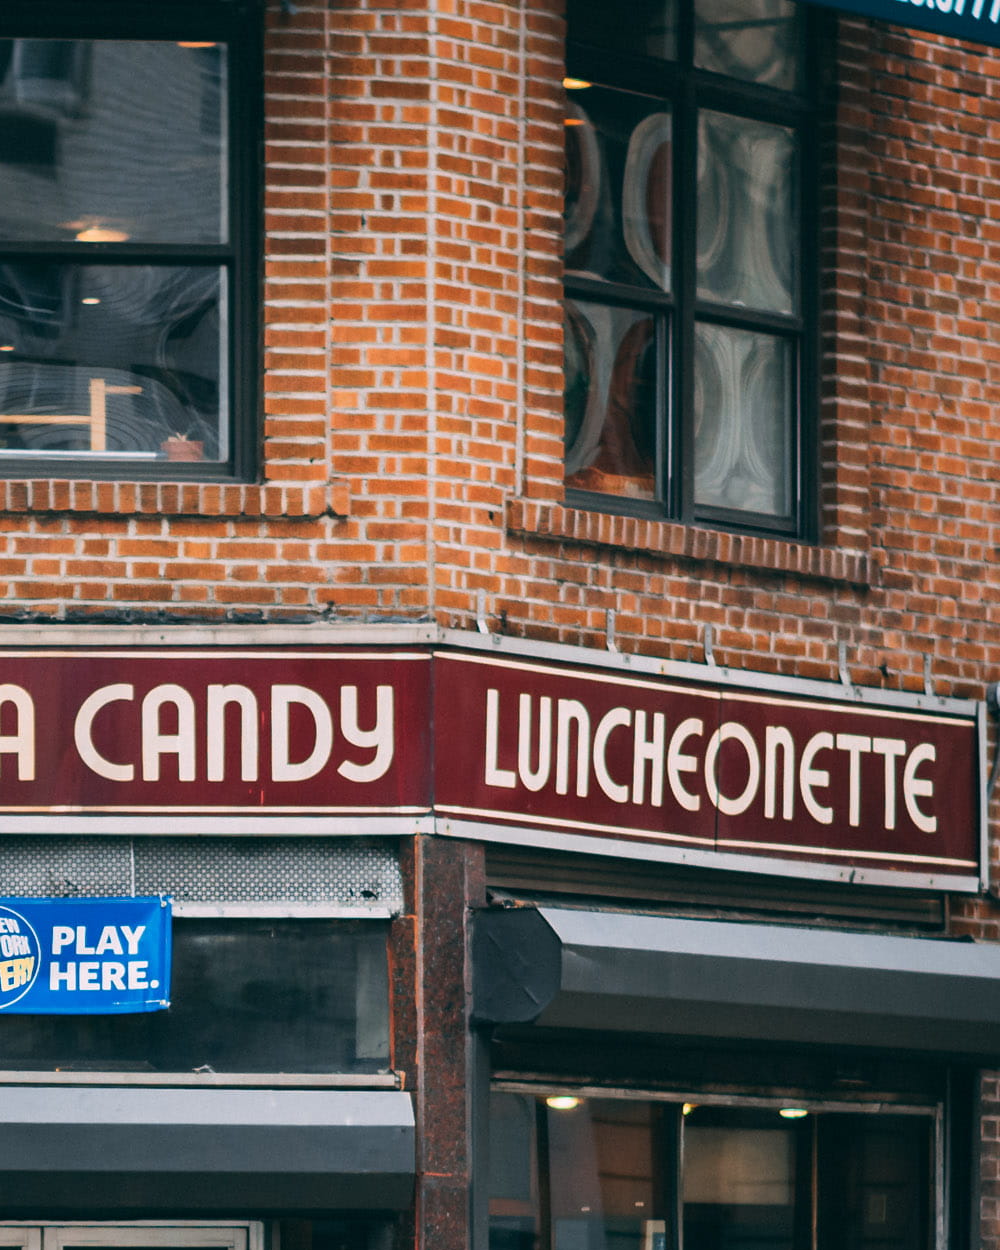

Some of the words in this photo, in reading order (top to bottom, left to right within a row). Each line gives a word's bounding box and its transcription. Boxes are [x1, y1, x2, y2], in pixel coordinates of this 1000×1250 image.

[74, 682, 395, 783] CANDY
[484, 688, 938, 833] LUNCHEONETTE
[51, 925, 146, 955] PLAY
[50, 961, 160, 991] HERE.
